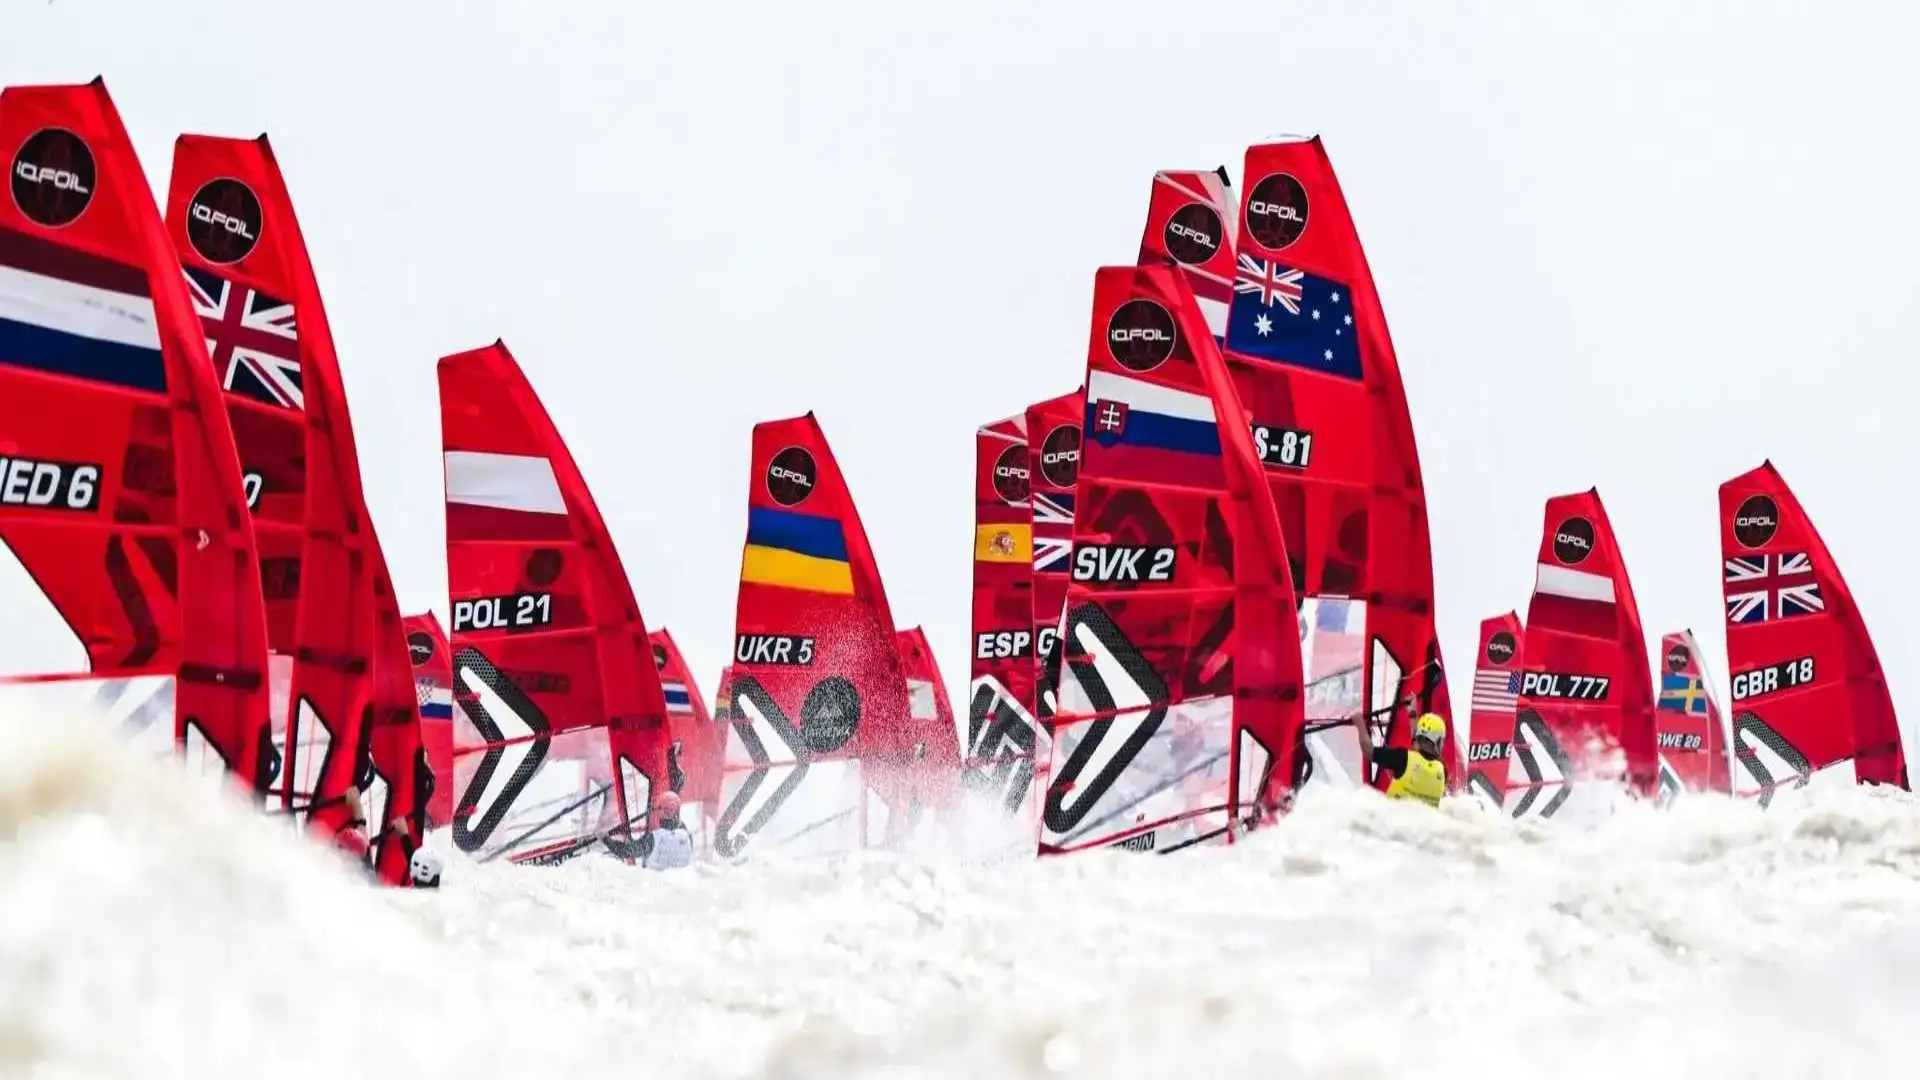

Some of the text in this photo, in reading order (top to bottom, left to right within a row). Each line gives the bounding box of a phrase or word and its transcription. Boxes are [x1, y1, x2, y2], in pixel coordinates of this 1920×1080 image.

[1249, 425, 1312, 466] S-81
[67, 466, 97, 509] 6
[1073, 546, 1175, 580] SVK 2
[454, 594, 551, 631] POL 21
[736, 636, 814, 663] UKR 5
[977, 631, 1030, 659] ESP
[1521, 673, 1609, 699] POL 777
[1733, 658, 1813, 700] GBR 18
[1470, 744, 1501, 760] USA
